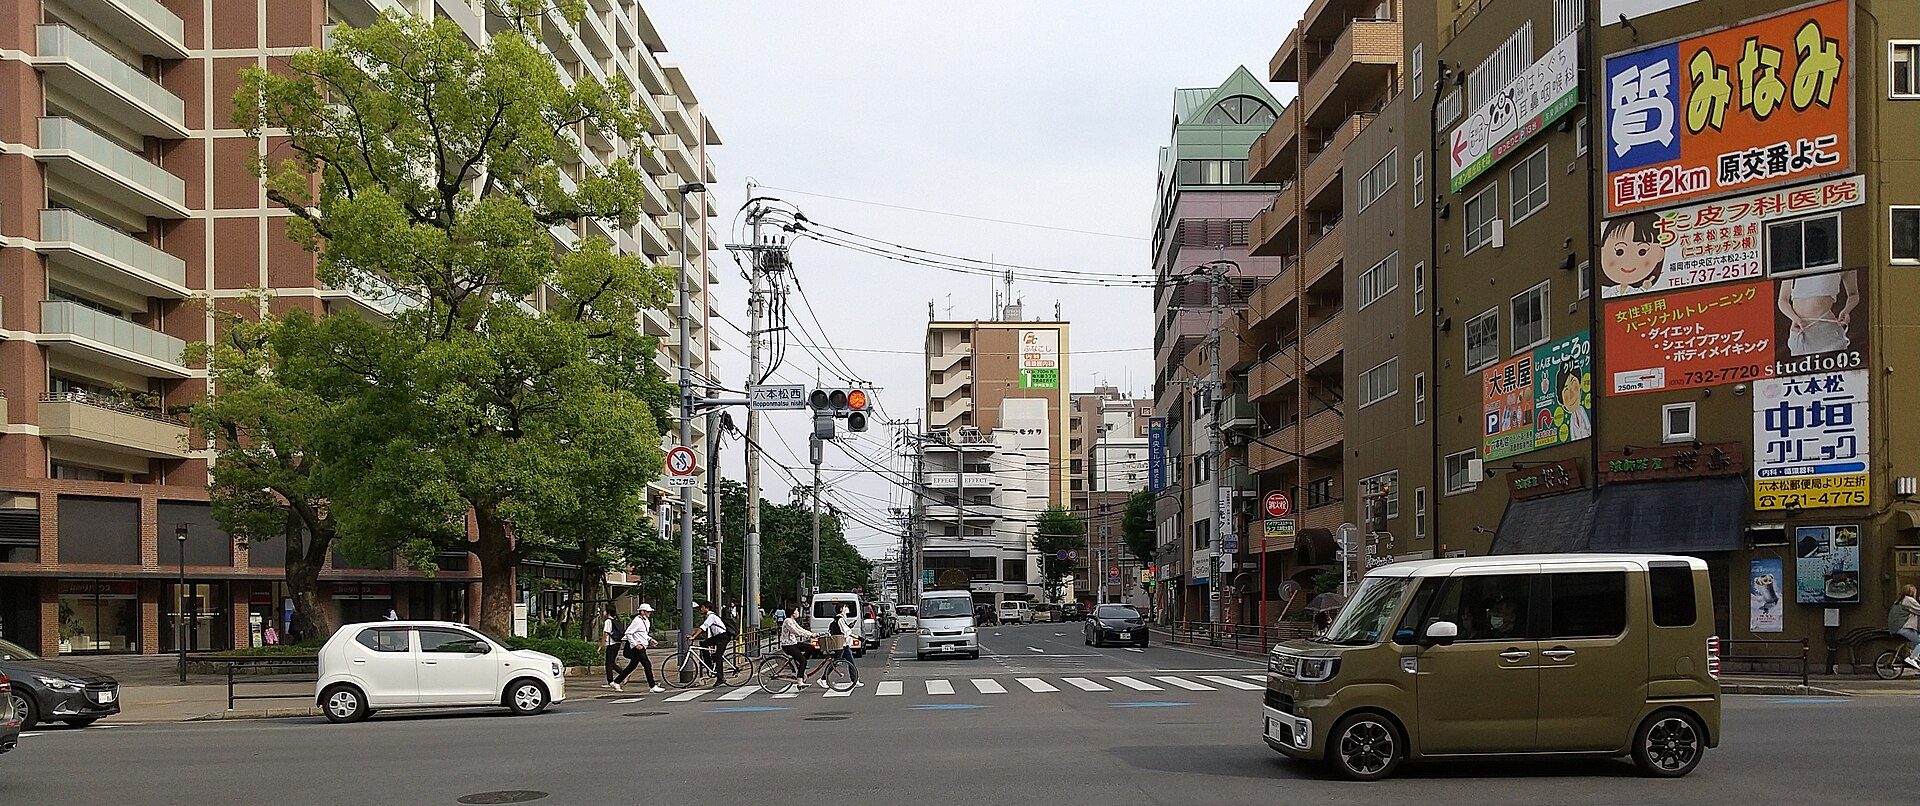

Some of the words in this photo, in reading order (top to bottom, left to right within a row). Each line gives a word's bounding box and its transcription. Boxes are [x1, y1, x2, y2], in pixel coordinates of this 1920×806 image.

[1526, 49, 1567, 93] はらぐち
[1611, 58, 1675, 158] 質
[1686, 19, 1844, 134] みなみ
[1615, 167, 1708, 204] 直進2km
[1719, 137, 1838, 184] 原交番よこ
[1680, 222, 1758, 246] 六本松交差点
[1615, 298, 1667, 323] 女性専用
[1626, 287, 1758, 333] パーソナルトレーニング
[1023, 345, 1052, 353] ふなこし
[1563, 355, 1591, 374] クリニック
[1488, 356, 1532, 398] 大黒屋
[1783, 374, 1845, 397] 六本松
[752, 400, 789, 408] Ropponmatsu
[790, 399, 804, 408] nishi
[753, 387, 802, 400] 六本松西
[1765, 395, 1855, 438] 中垣
[1766, 435, 1857, 464] クリニック
[669, 477, 696, 485] ここから
[1758, 476, 1866, 492] 六本松郵便局より左折
[1268, 500, 1287, 509] 消火栓
